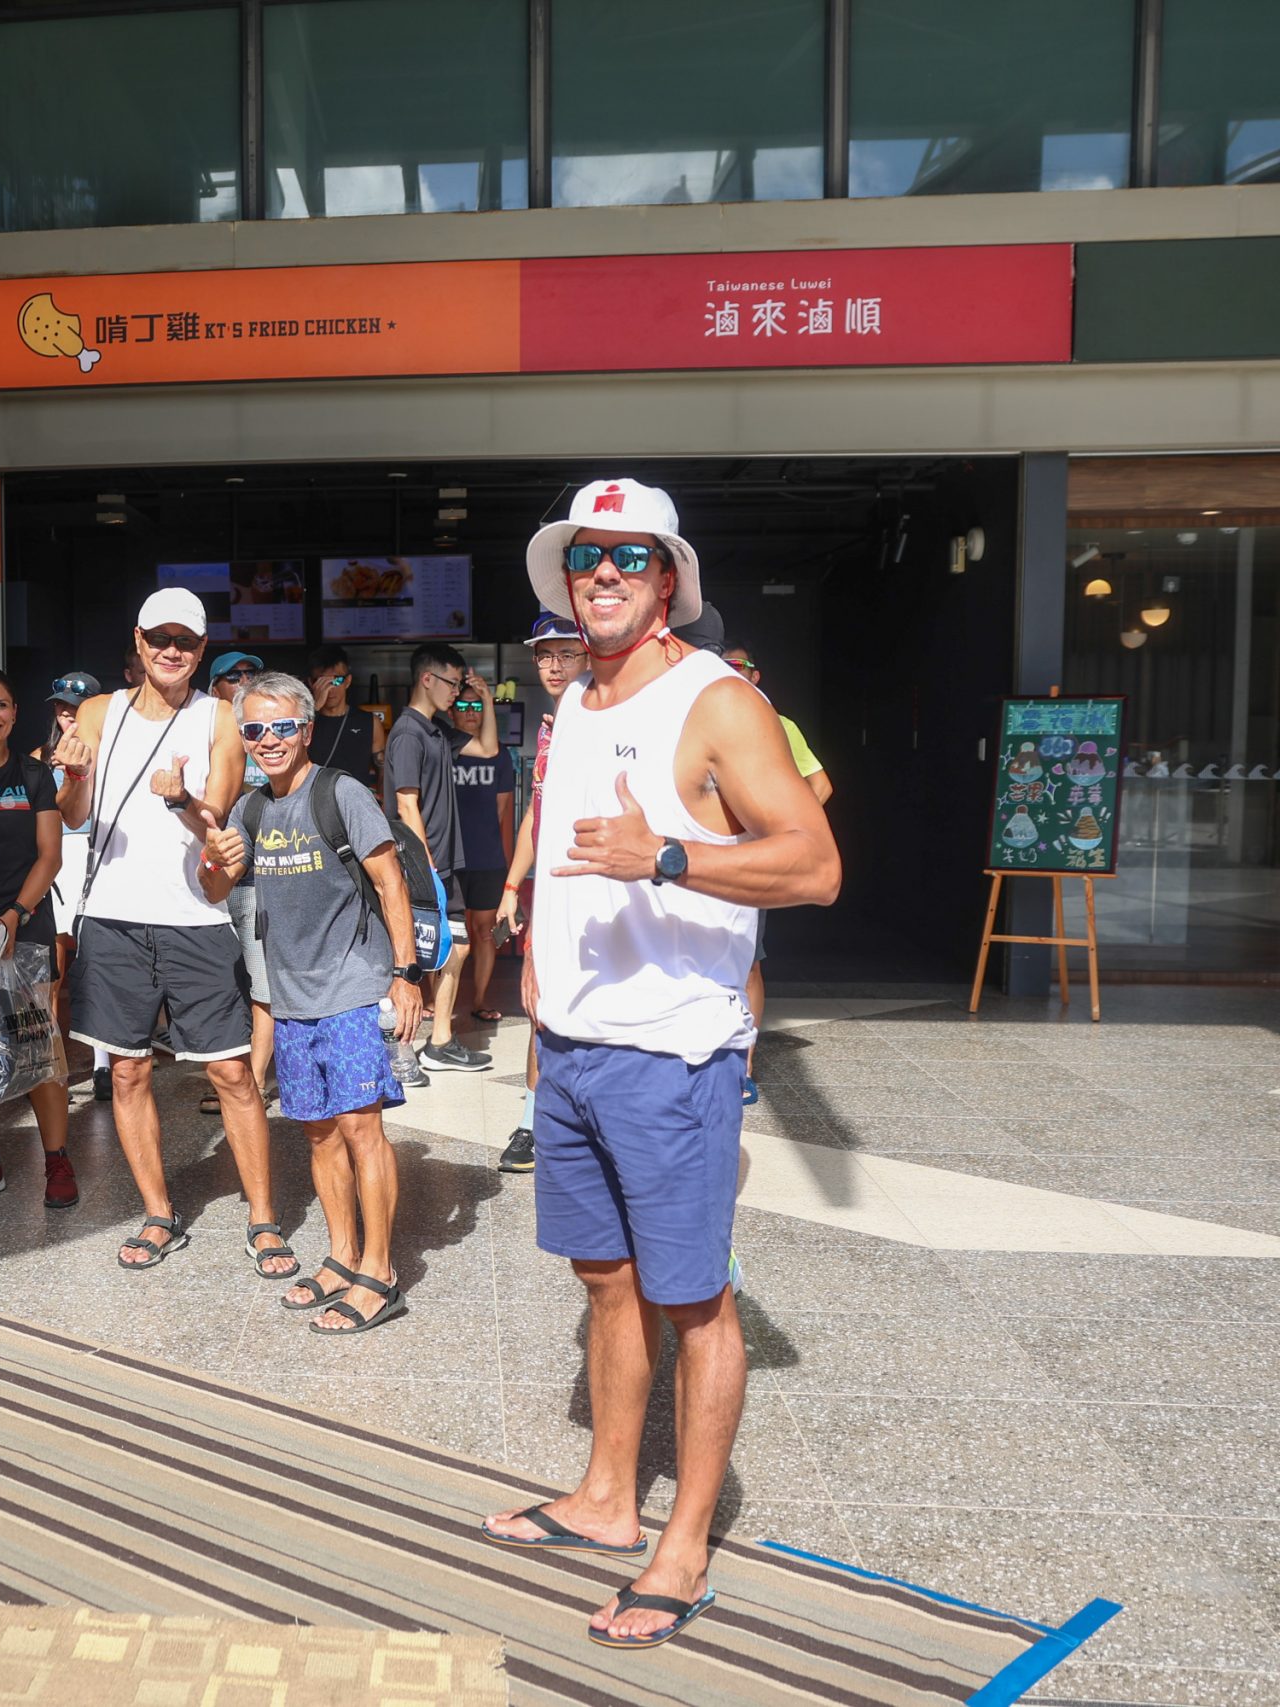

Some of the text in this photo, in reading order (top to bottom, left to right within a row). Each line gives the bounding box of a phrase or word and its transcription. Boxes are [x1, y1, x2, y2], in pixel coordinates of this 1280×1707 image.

[706, 278, 832, 292] Taiwanese Luwei
[704, 297, 882, 337] 滷來滷順
[95, 311, 200, 344] 啃丁雞
[248, 319, 299, 338] FRIED
[304, 317, 382, 336] CHICKEN
[1002, 848, 1038, 864] 牛奶
[359, 1081, 377, 1091] TYR
